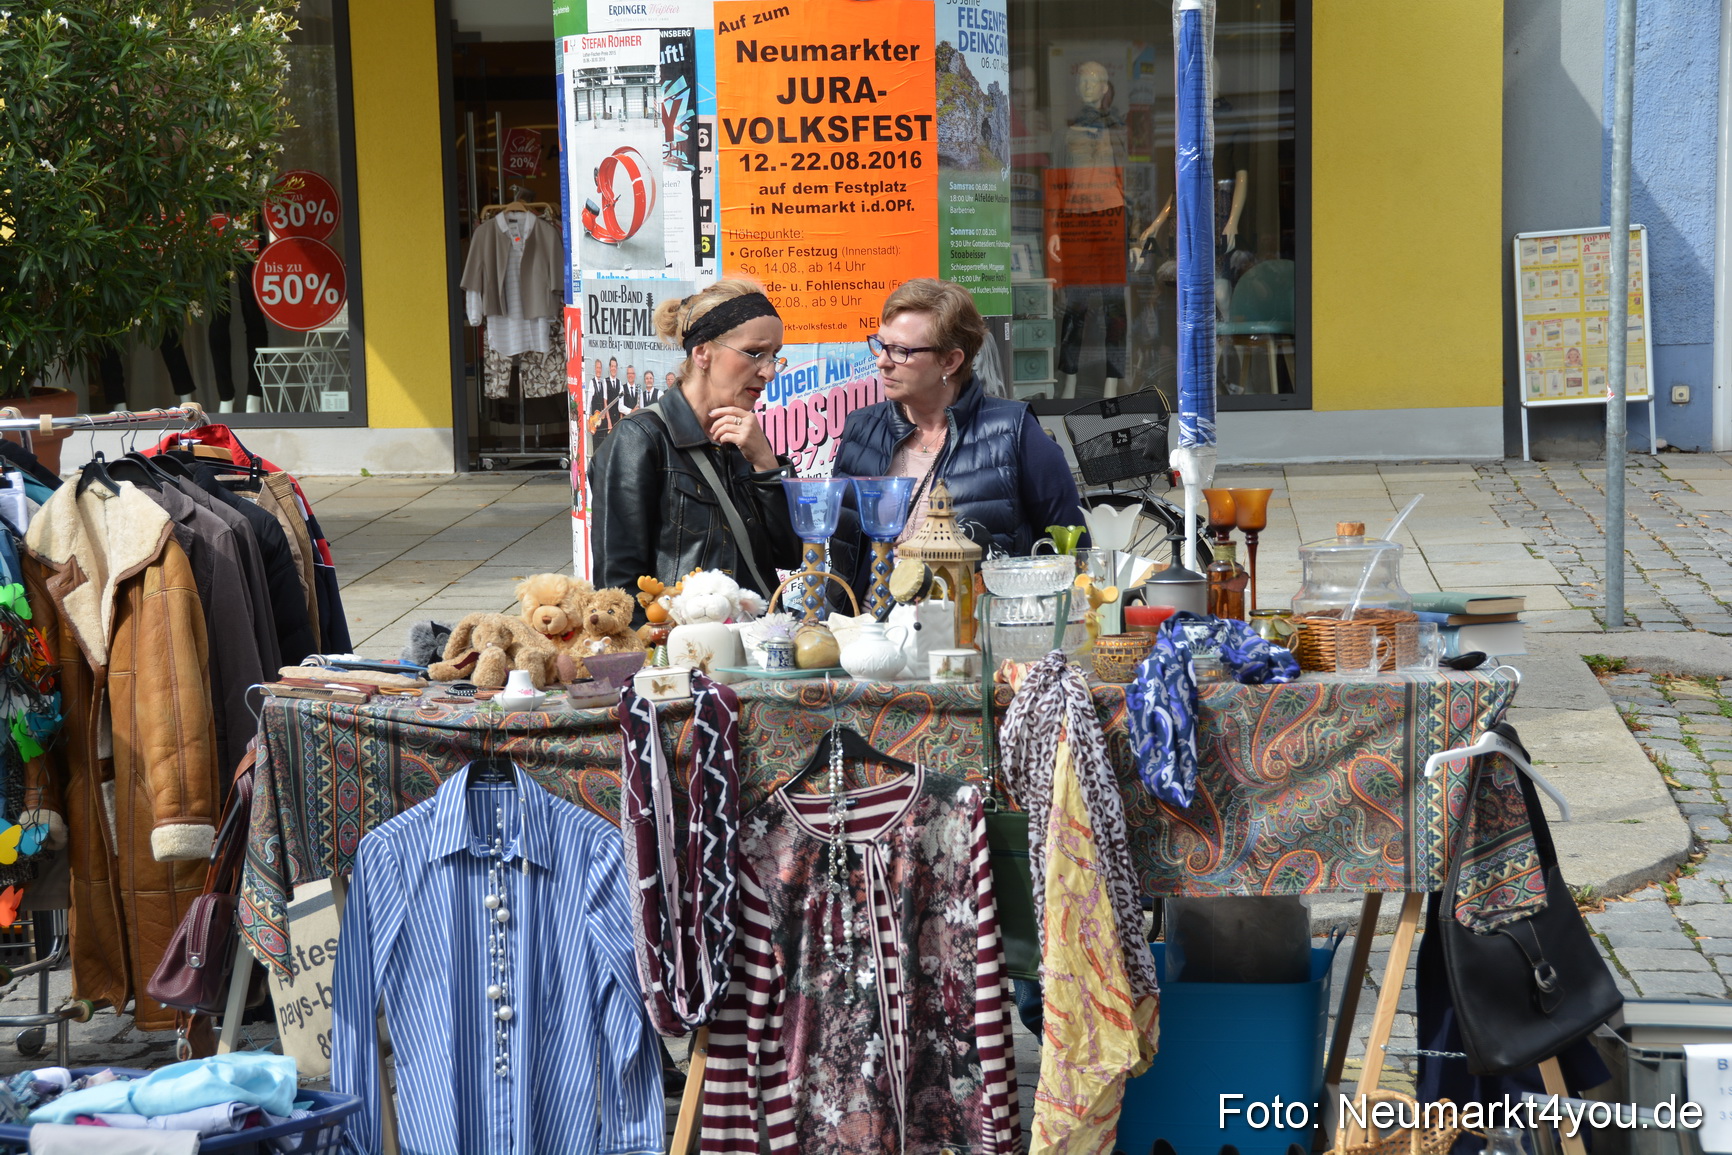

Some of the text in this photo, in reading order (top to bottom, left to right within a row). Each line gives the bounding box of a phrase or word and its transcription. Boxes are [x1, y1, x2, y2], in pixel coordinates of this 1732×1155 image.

[608, 4, 648, 16] ERDINGER
[718, 6, 790, 35] Auf zum
[582, 35, 642, 50] STEFAN ROHRER
[736, 38, 920, 62] Neumarkter
[776, 76, 887, 104] JURA-
[722, 114, 932, 144] VOLKSFEST
[510, 136, 538, 153] Sale
[510, 157, 534, 168] 20%
[759, 180, 907, 196] auf dem Festplatz
[271, 199, 334, 230] 30%
[750, 200, 915, 215] in Neumarkt i.d.OPf.
[729, 228, 804, 242] Höhepunkte:
[740, 245, 901, 259] Großer Festzug (Innenstadt):
[264, 262, 302, 273] bis zu
[740, 261, 866, 276] So, 14.08., ab 14 Uhr
[262, 273, 339, 305] 50%
[791, 282, 802, 291] u.
[806, 280, 885, 291] Fohlenschau
[812, 296, 826, 307] ab
[830, 296, 837, 306] 9
[842, 295, 862, 306] Uhr
[784, 322, 847, 332] rkt-volksfest.de
[623, 341, 633, 350] UND
[854, 363, 877, 375] Neum
